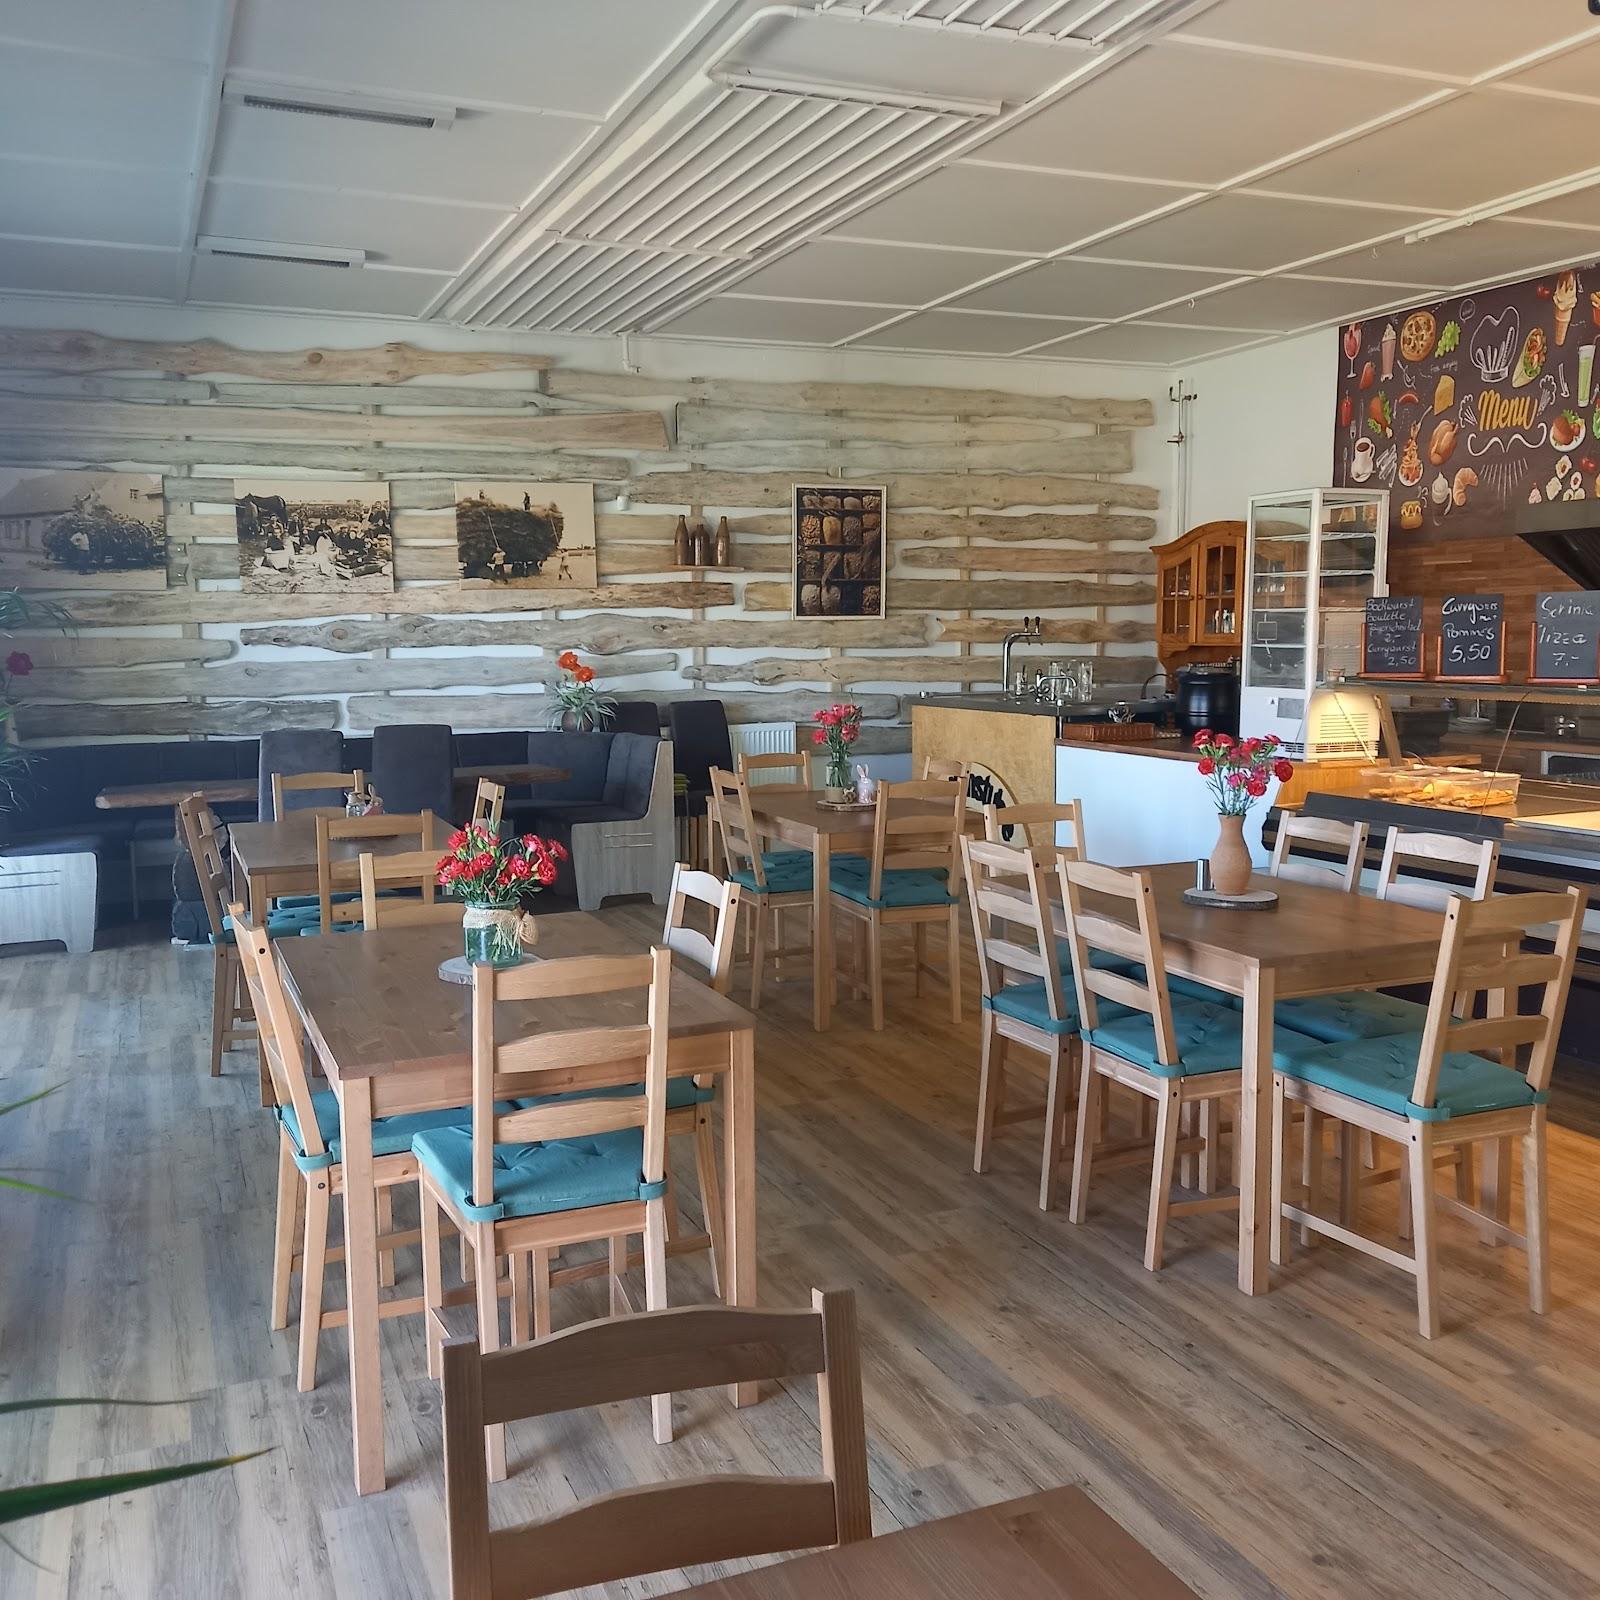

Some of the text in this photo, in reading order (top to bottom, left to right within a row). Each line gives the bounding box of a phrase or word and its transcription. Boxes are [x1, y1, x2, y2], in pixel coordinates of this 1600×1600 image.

[1477, 389, 1538, 431] Menu
[1387, 656, 1417, 667] 2,50
[1448, 643, 1492, 663] 5,50
